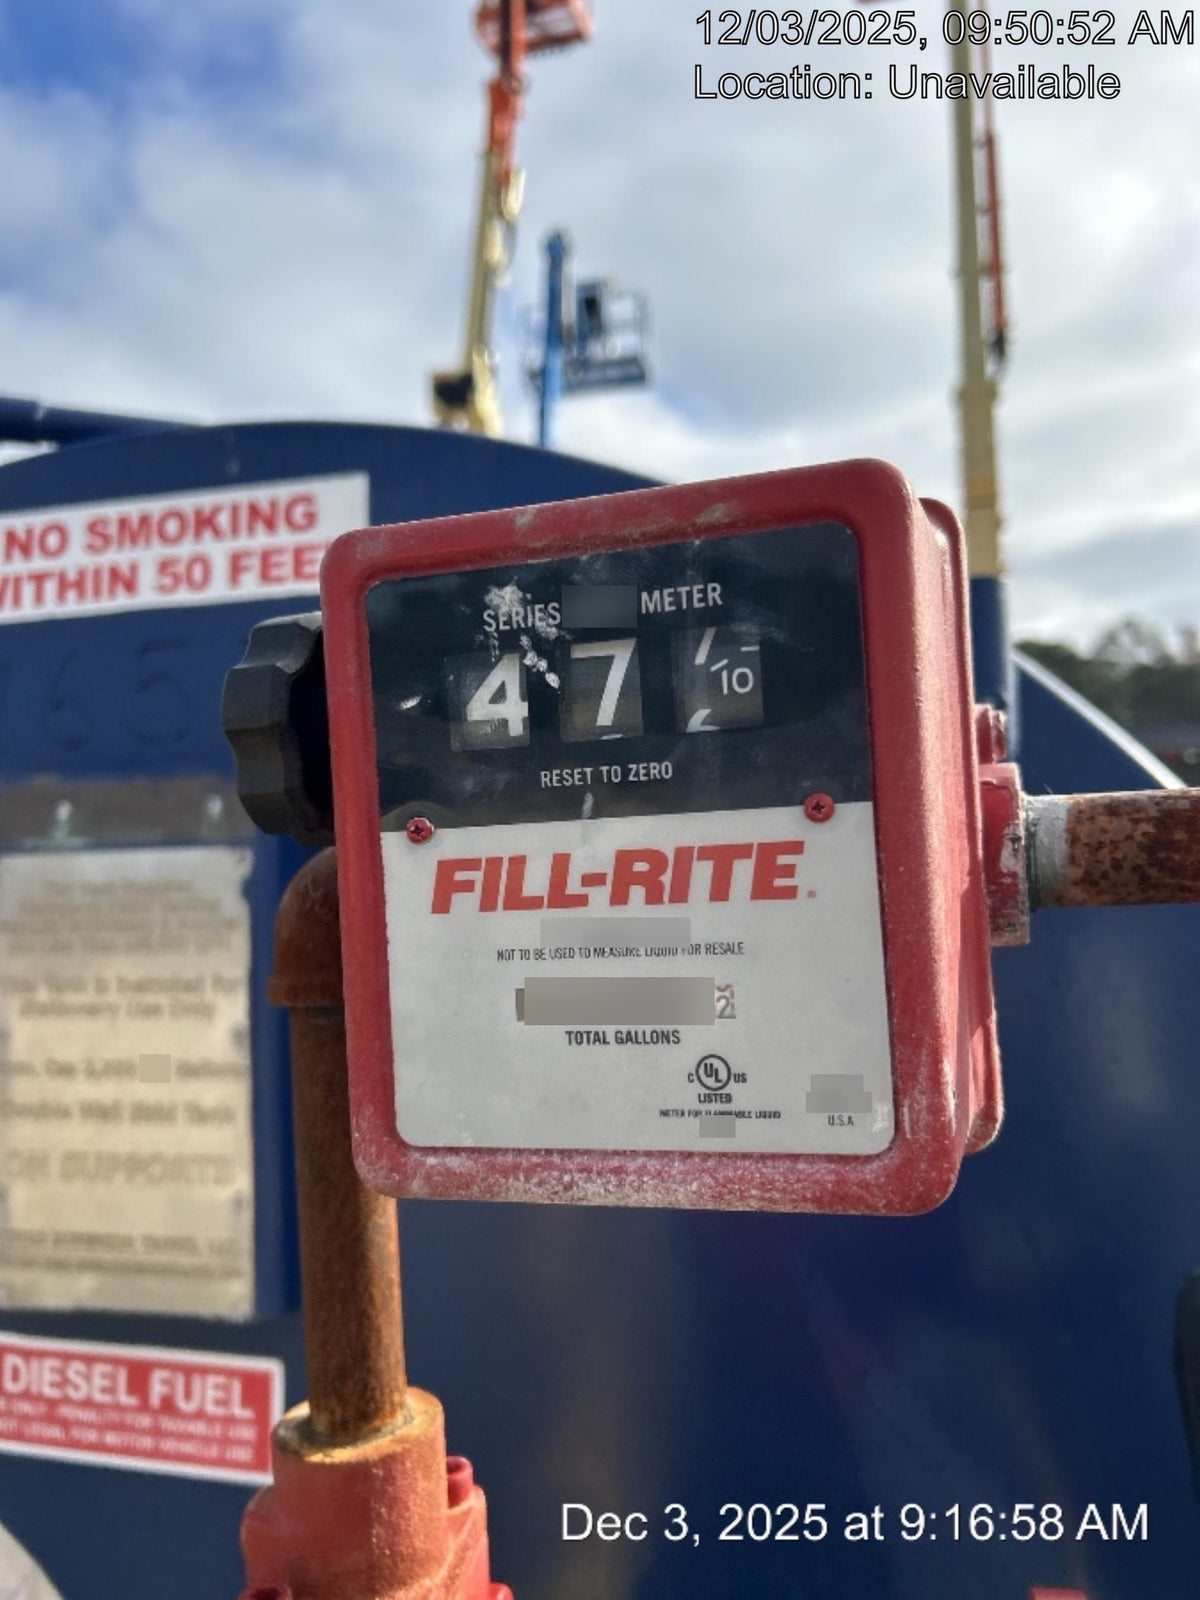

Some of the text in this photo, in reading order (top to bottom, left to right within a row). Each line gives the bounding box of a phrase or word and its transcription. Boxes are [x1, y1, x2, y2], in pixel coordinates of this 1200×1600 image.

[4, 494, 317, 562] NO SMOKING
[0, 543, 331, 612] ITHIN 50 FEE
[483, 602, 561, 632] SERIES
[640, 582, 722, 614] METER
[467, 652, 529, 737] 4
[570, 637, 637, 726] 7
[540, 761, 674, 788] RESET TO ZERO
[497, 949, 516, 962] NOT
[519, 949, 531, 961] TO
[534, 948, 547, 961] BE
[550, 948, 575, 960] USED
[578, 948, 591, 960] TO
[705, 941, 745, 956] RESALE
[565, 1029, 681, 1046] TOTAL GALLONS
[733, 1073, 747, 1083] US
[697, 1093, 732, 1104] LISTED
[3, 1353, 256, 1419] DIESEL FUEL
